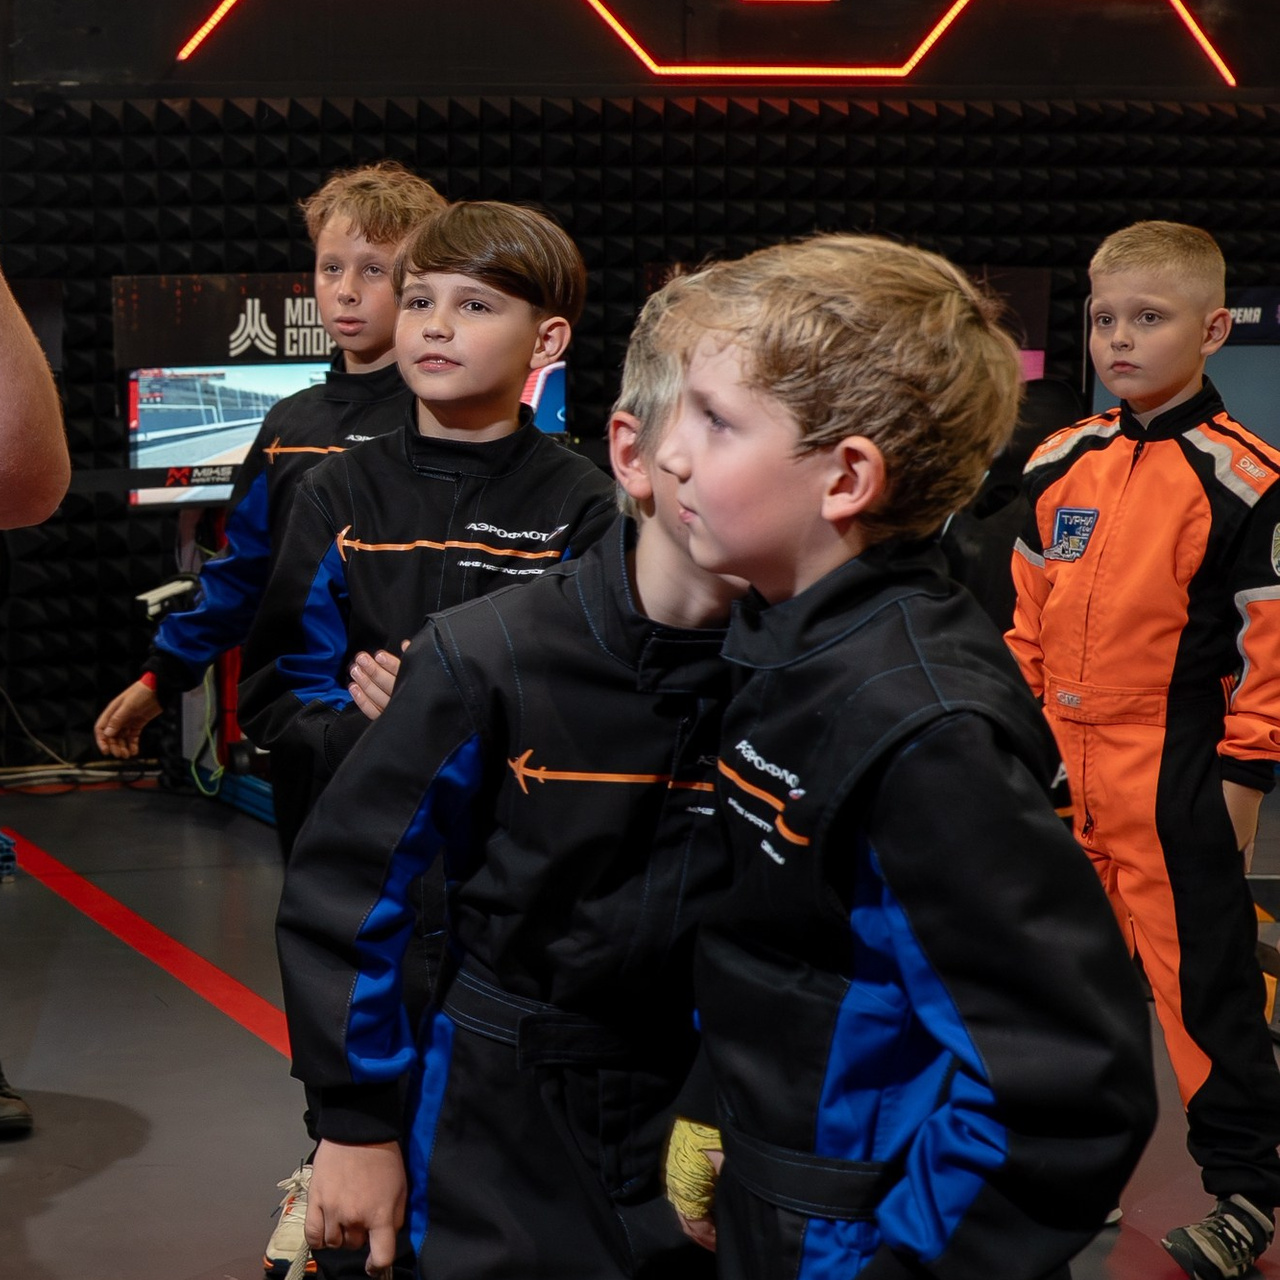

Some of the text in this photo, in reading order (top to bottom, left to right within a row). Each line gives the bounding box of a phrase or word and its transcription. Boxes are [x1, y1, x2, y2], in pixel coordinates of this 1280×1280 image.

[1230, 307, 1262, 324] РЕМЯ
[284, 327, 337, 356] СПОР
[465, 522, 549, 542] АЭРОФЛОТ
